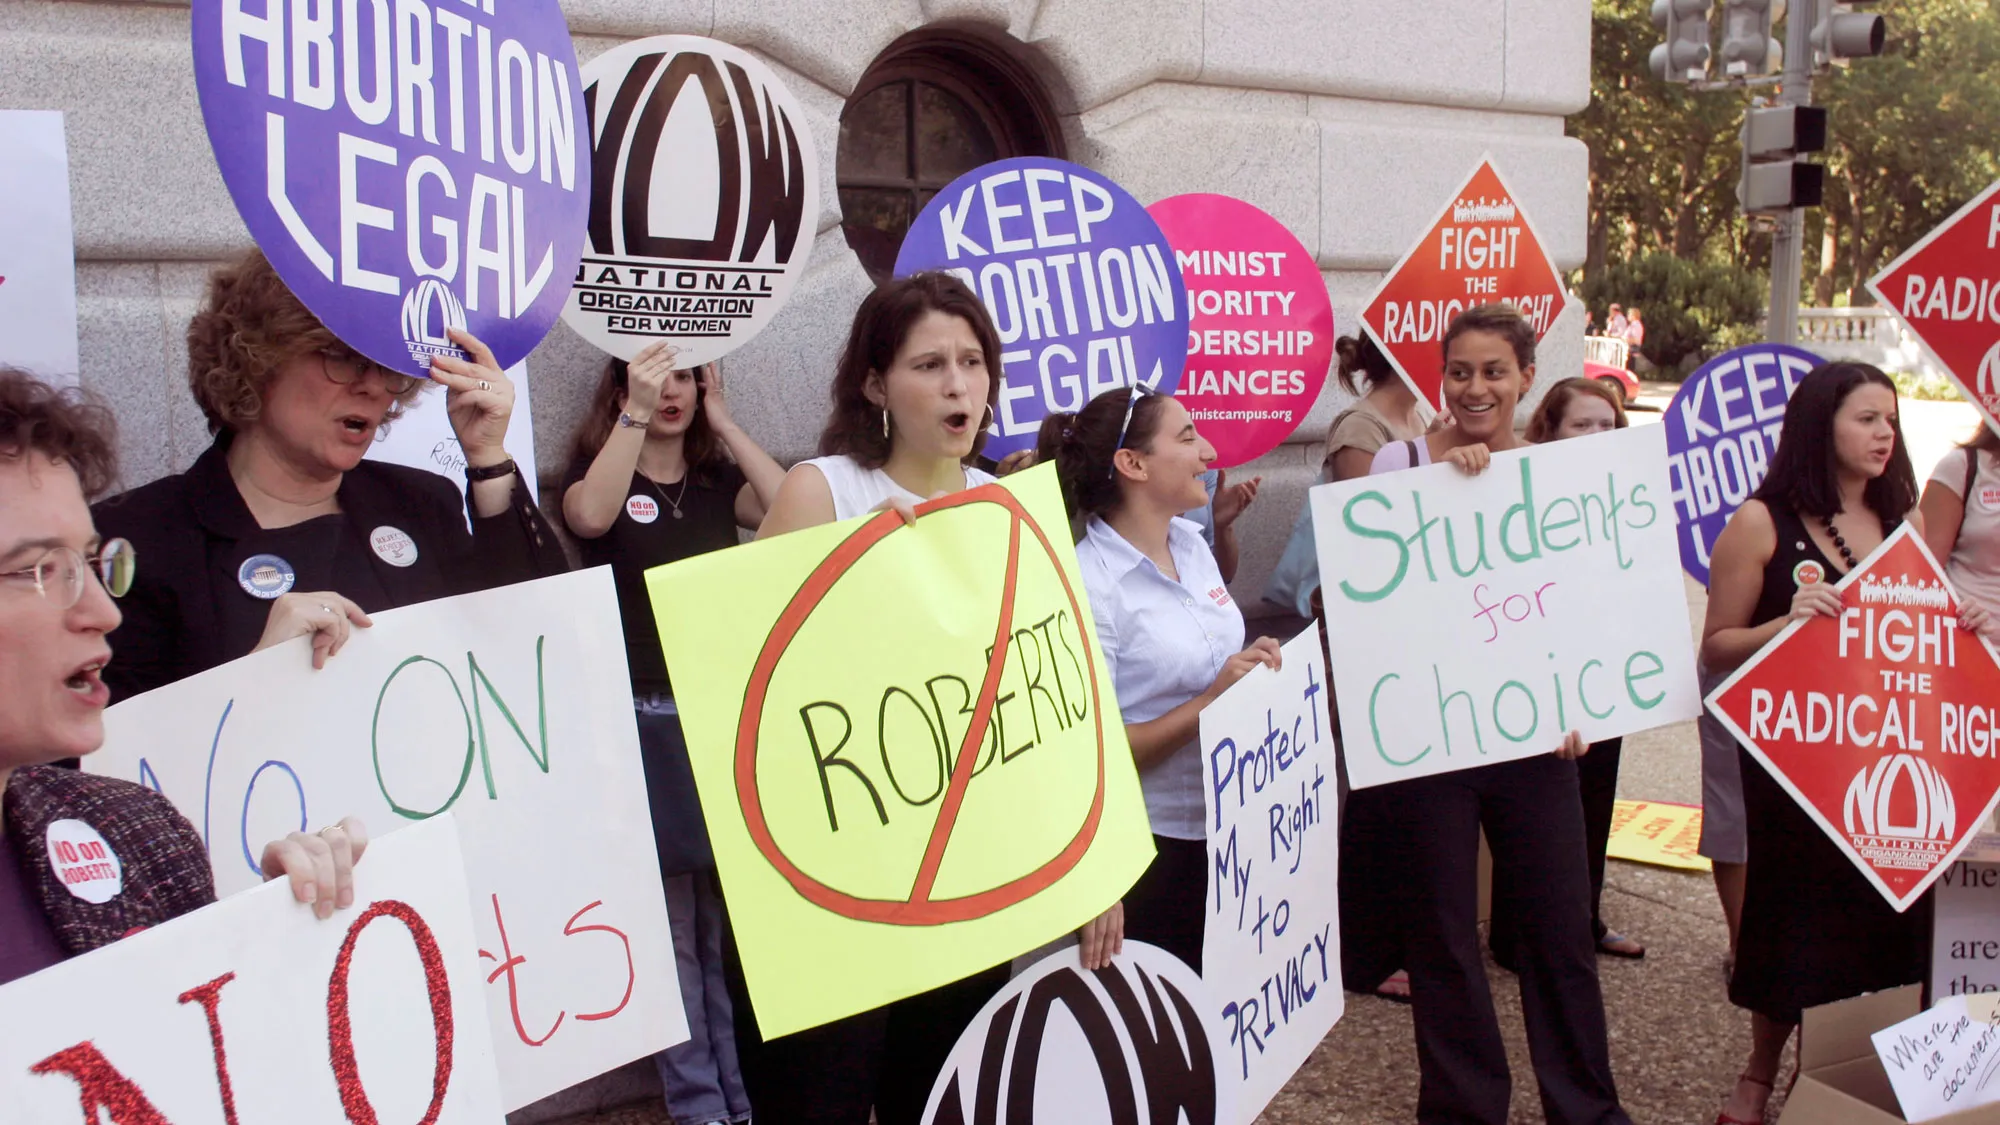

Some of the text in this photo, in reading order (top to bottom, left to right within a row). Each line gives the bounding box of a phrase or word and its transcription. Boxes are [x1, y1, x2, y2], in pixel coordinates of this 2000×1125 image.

[221, 0, 575, 191] ABORTION
[583, 51, 804, 264] NOW
[267, 112, 554, 320] LEGAL
[940, 168, 1114, 260] KEEP
[1440, 226, 1521, 270] FIGHT
[401, 280, 468, 348] NOW
[578, 291, 754, 314] ORGANIZATION
[944, 244, 1175, 345] ORTION
[1464, 276, 1498, 294] THE
[1903, 274, 2000, 324] RADI
[407, 344, 463, 358] NATIONAL
[607, 315, 731, 332] FOR WOMEN
[1383, 298, 1487, 344] RADIC
[988, 335, 1163, 438] EGAL
[1187, 408, 1293, 423] inistcampus.org
[1339, 457, 1657, 603] Students
[1473, 581, 1557, 643] for
[1838, 607, 1957, 667] FIGHT
[1368, 650, 1667, 767] Choice
[1879, 669, 1932, 695] THE
[371, 634, 549, 820] ON
[799, 608, 1087, 832] ROBERTS
[1210, 663, 1320, 834] Protect
[1749, 687, 1923, 751] RADICAL
[1843, 753, 1956, 840] NOW
[52, 840, 107, 864] NO on
[62, 862, 116, 884] ROBERTS
[1215, 763, 1325, 931] My Right
[1853, 837, 1947, 852] NATIONAL
[1861, 848, 1938, 863] ORGANIZATION
[1252, 898, 1289, 955] to
[1951, 939, 2000, 960] are
[29, 900, 455, 1125] NO
[1886, 1022, 1948, 1071] Where
[1923, 1015, 1970, 1081] are the
